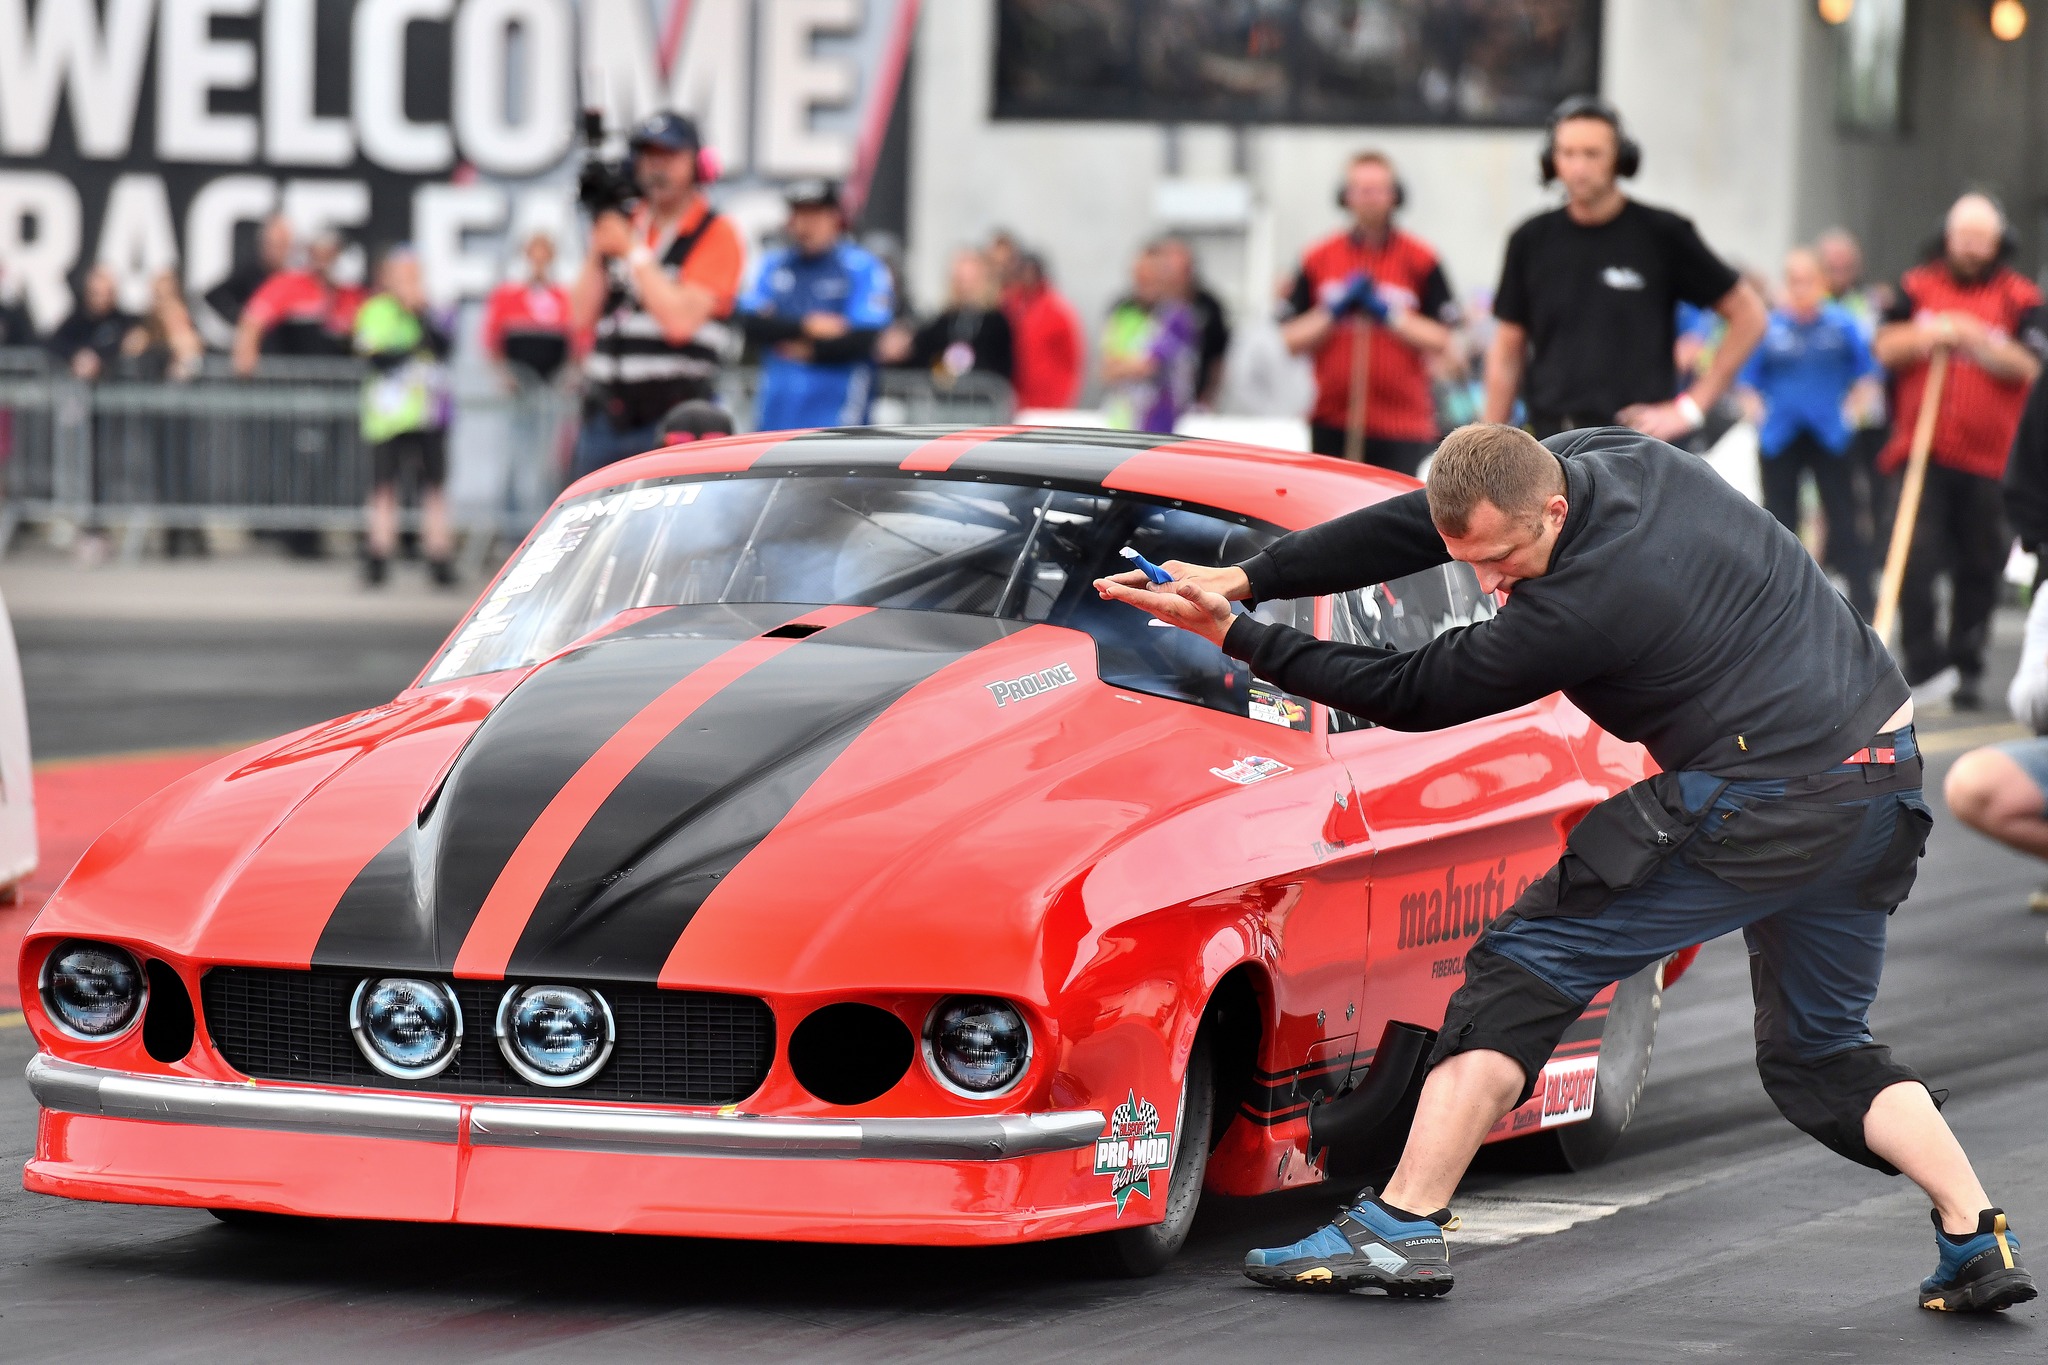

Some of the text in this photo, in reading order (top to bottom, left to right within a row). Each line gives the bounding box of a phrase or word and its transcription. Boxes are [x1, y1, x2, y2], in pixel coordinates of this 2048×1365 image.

[0, 0, 856, 175] WELCOME
[631, 485, 703, 512] 911
[986, 663, 1077, 708] PROLINE
[1544, 1068, 1595, 1116] BILSPORT
[1120, 1121, 1146, 1136] BILSPORT
[1112, 1162, 1150, 1189] series
[1405, 1238, 1443, 1247] SALOMON
